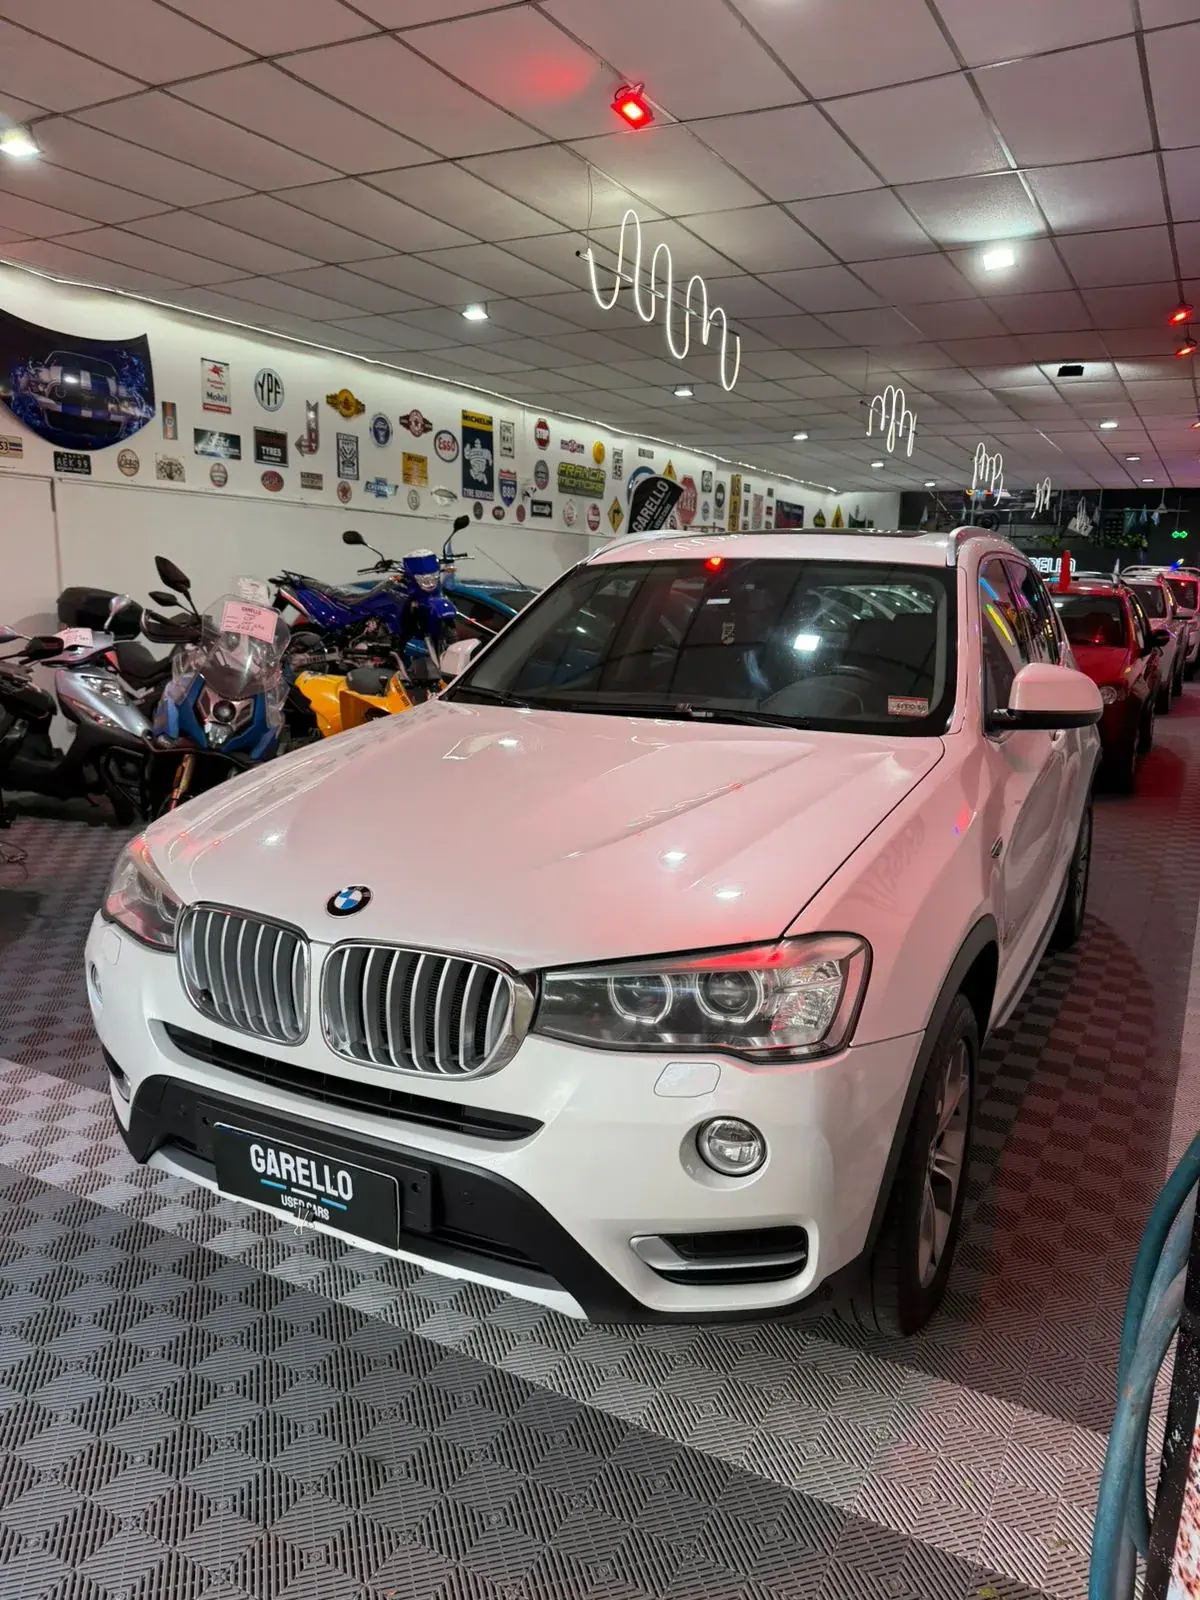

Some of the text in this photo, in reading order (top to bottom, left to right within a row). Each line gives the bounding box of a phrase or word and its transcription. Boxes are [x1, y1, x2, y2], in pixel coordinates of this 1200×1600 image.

[206, 391, 228, 403] Mobil
[258, 373, 281, 406] YPF
[261, 446, 282, 457] TYRES
[632, 480, 670, 532] GARELLO
[250, 1144, 353, 1201] GARELLO
